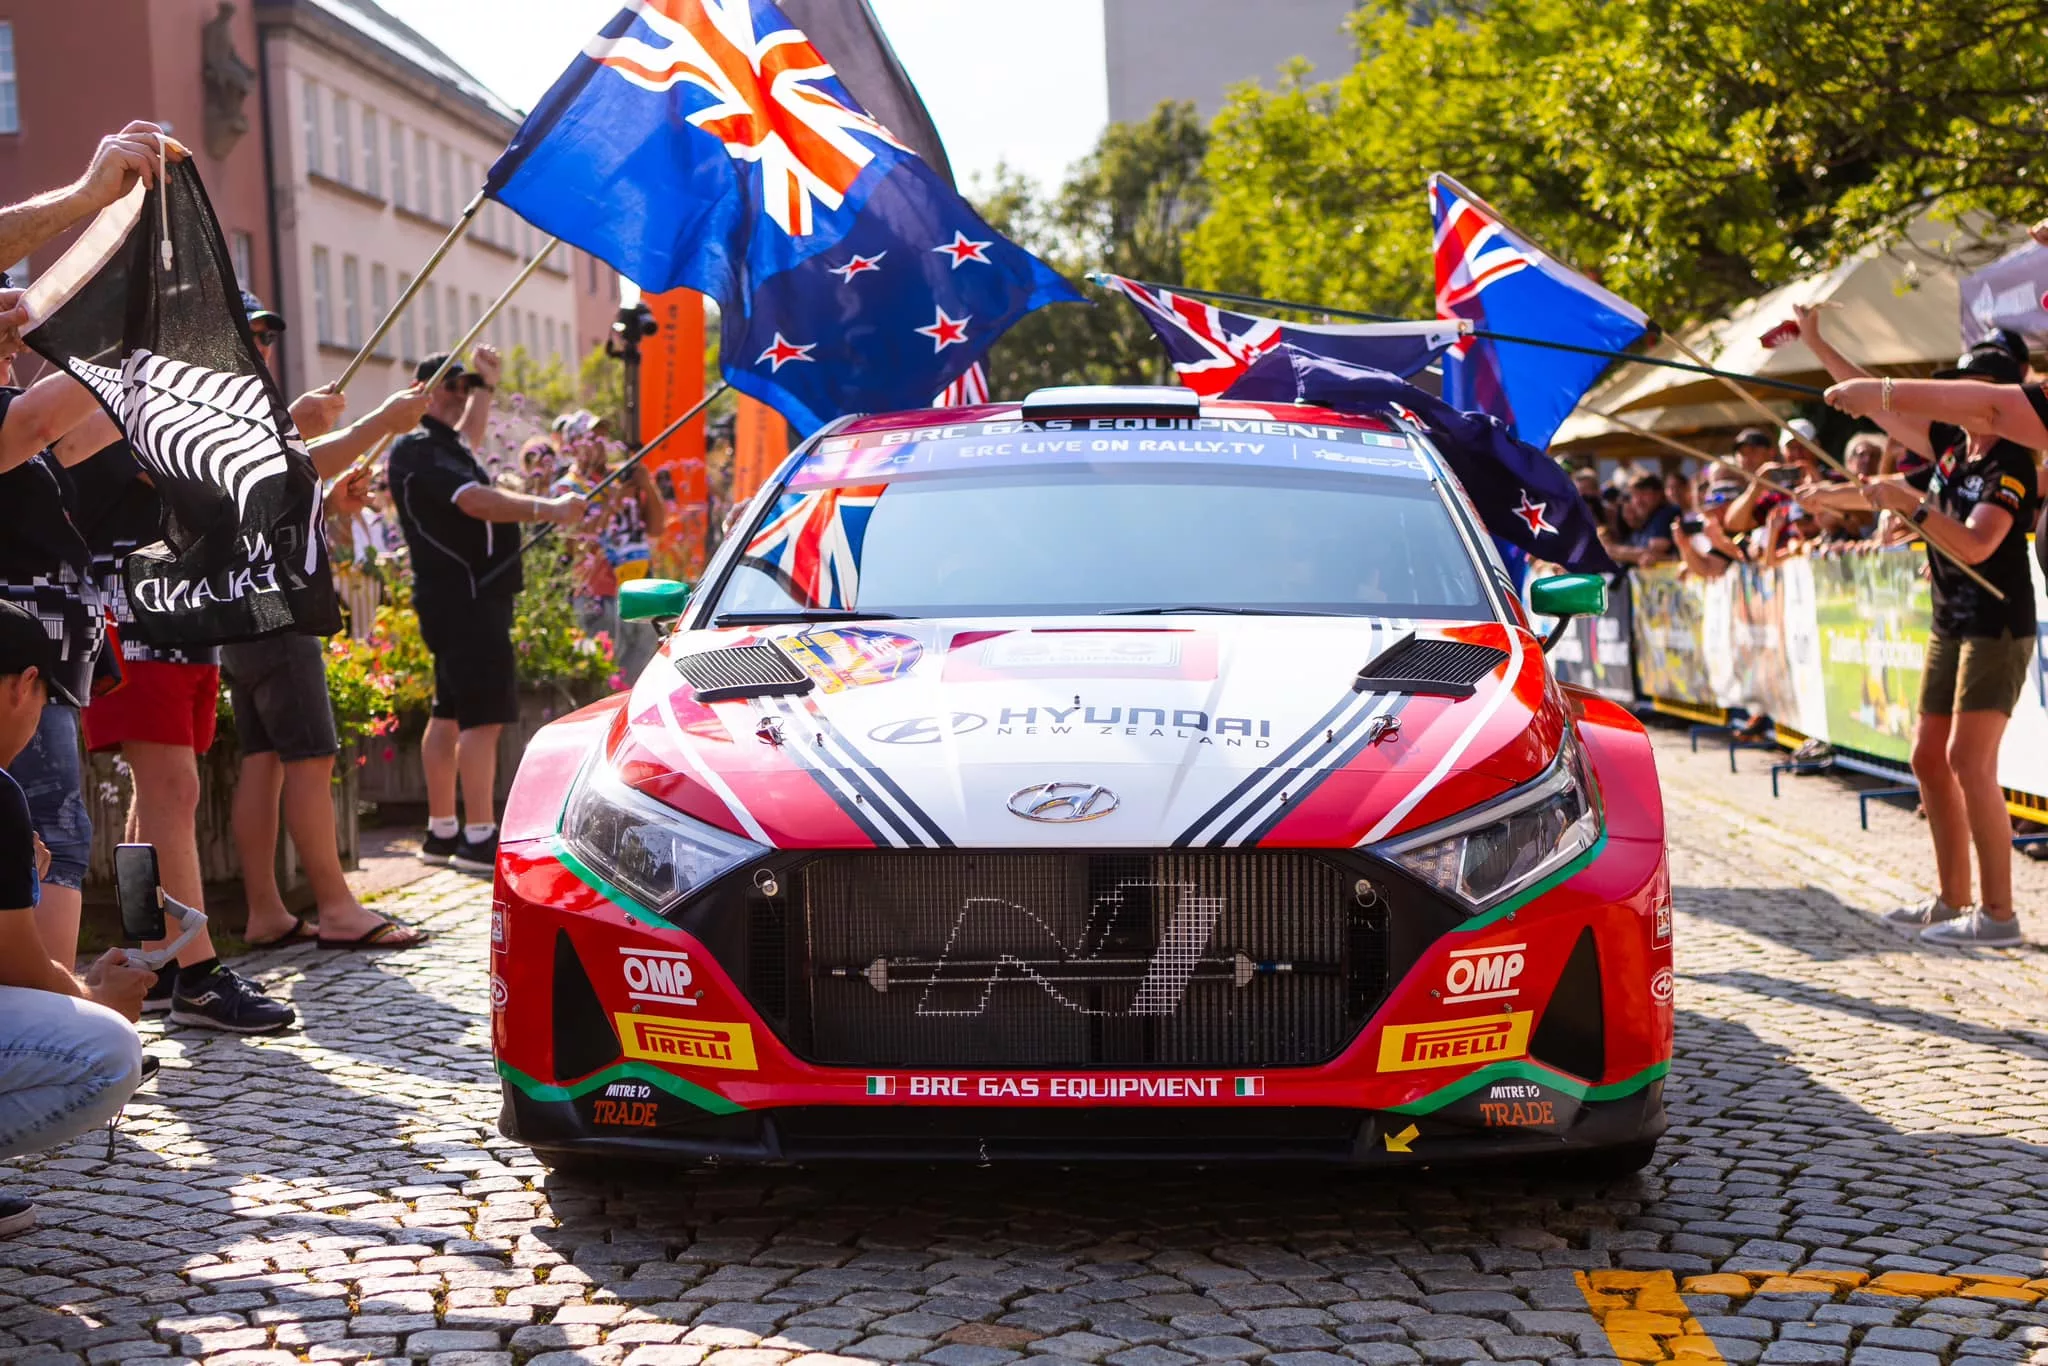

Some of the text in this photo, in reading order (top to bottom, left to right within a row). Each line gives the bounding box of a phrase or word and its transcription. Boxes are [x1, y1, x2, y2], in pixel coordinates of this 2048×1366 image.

[881, 417, 1345, 446] BRC GAS EQUIPMENT
[959, 439, 1265, 458] ERC LIVE ON RALLY.TV
[1000, 706, 1271, 738] HYUNDAI
[996, 726, 1271, 749] NEW ZEALAND
[623, 956, 693, 996] OMP
[1446, 952, 1525, 994] OMP
[633, 1021, 733, 1061] PIRELLI
[1400, 1020, 1513, 1063] PIRELLI
[605, 1083, 651, 1098] MITRE 10
[909, 1076, 1223, 1099] BRC GAS EQUIPMENT
[1490, 1085, 1541, 1099] MITRE 10
[593, 1099, 658, 1127] TRADE
[1479, 1101, 1556, 1127] TRADE
